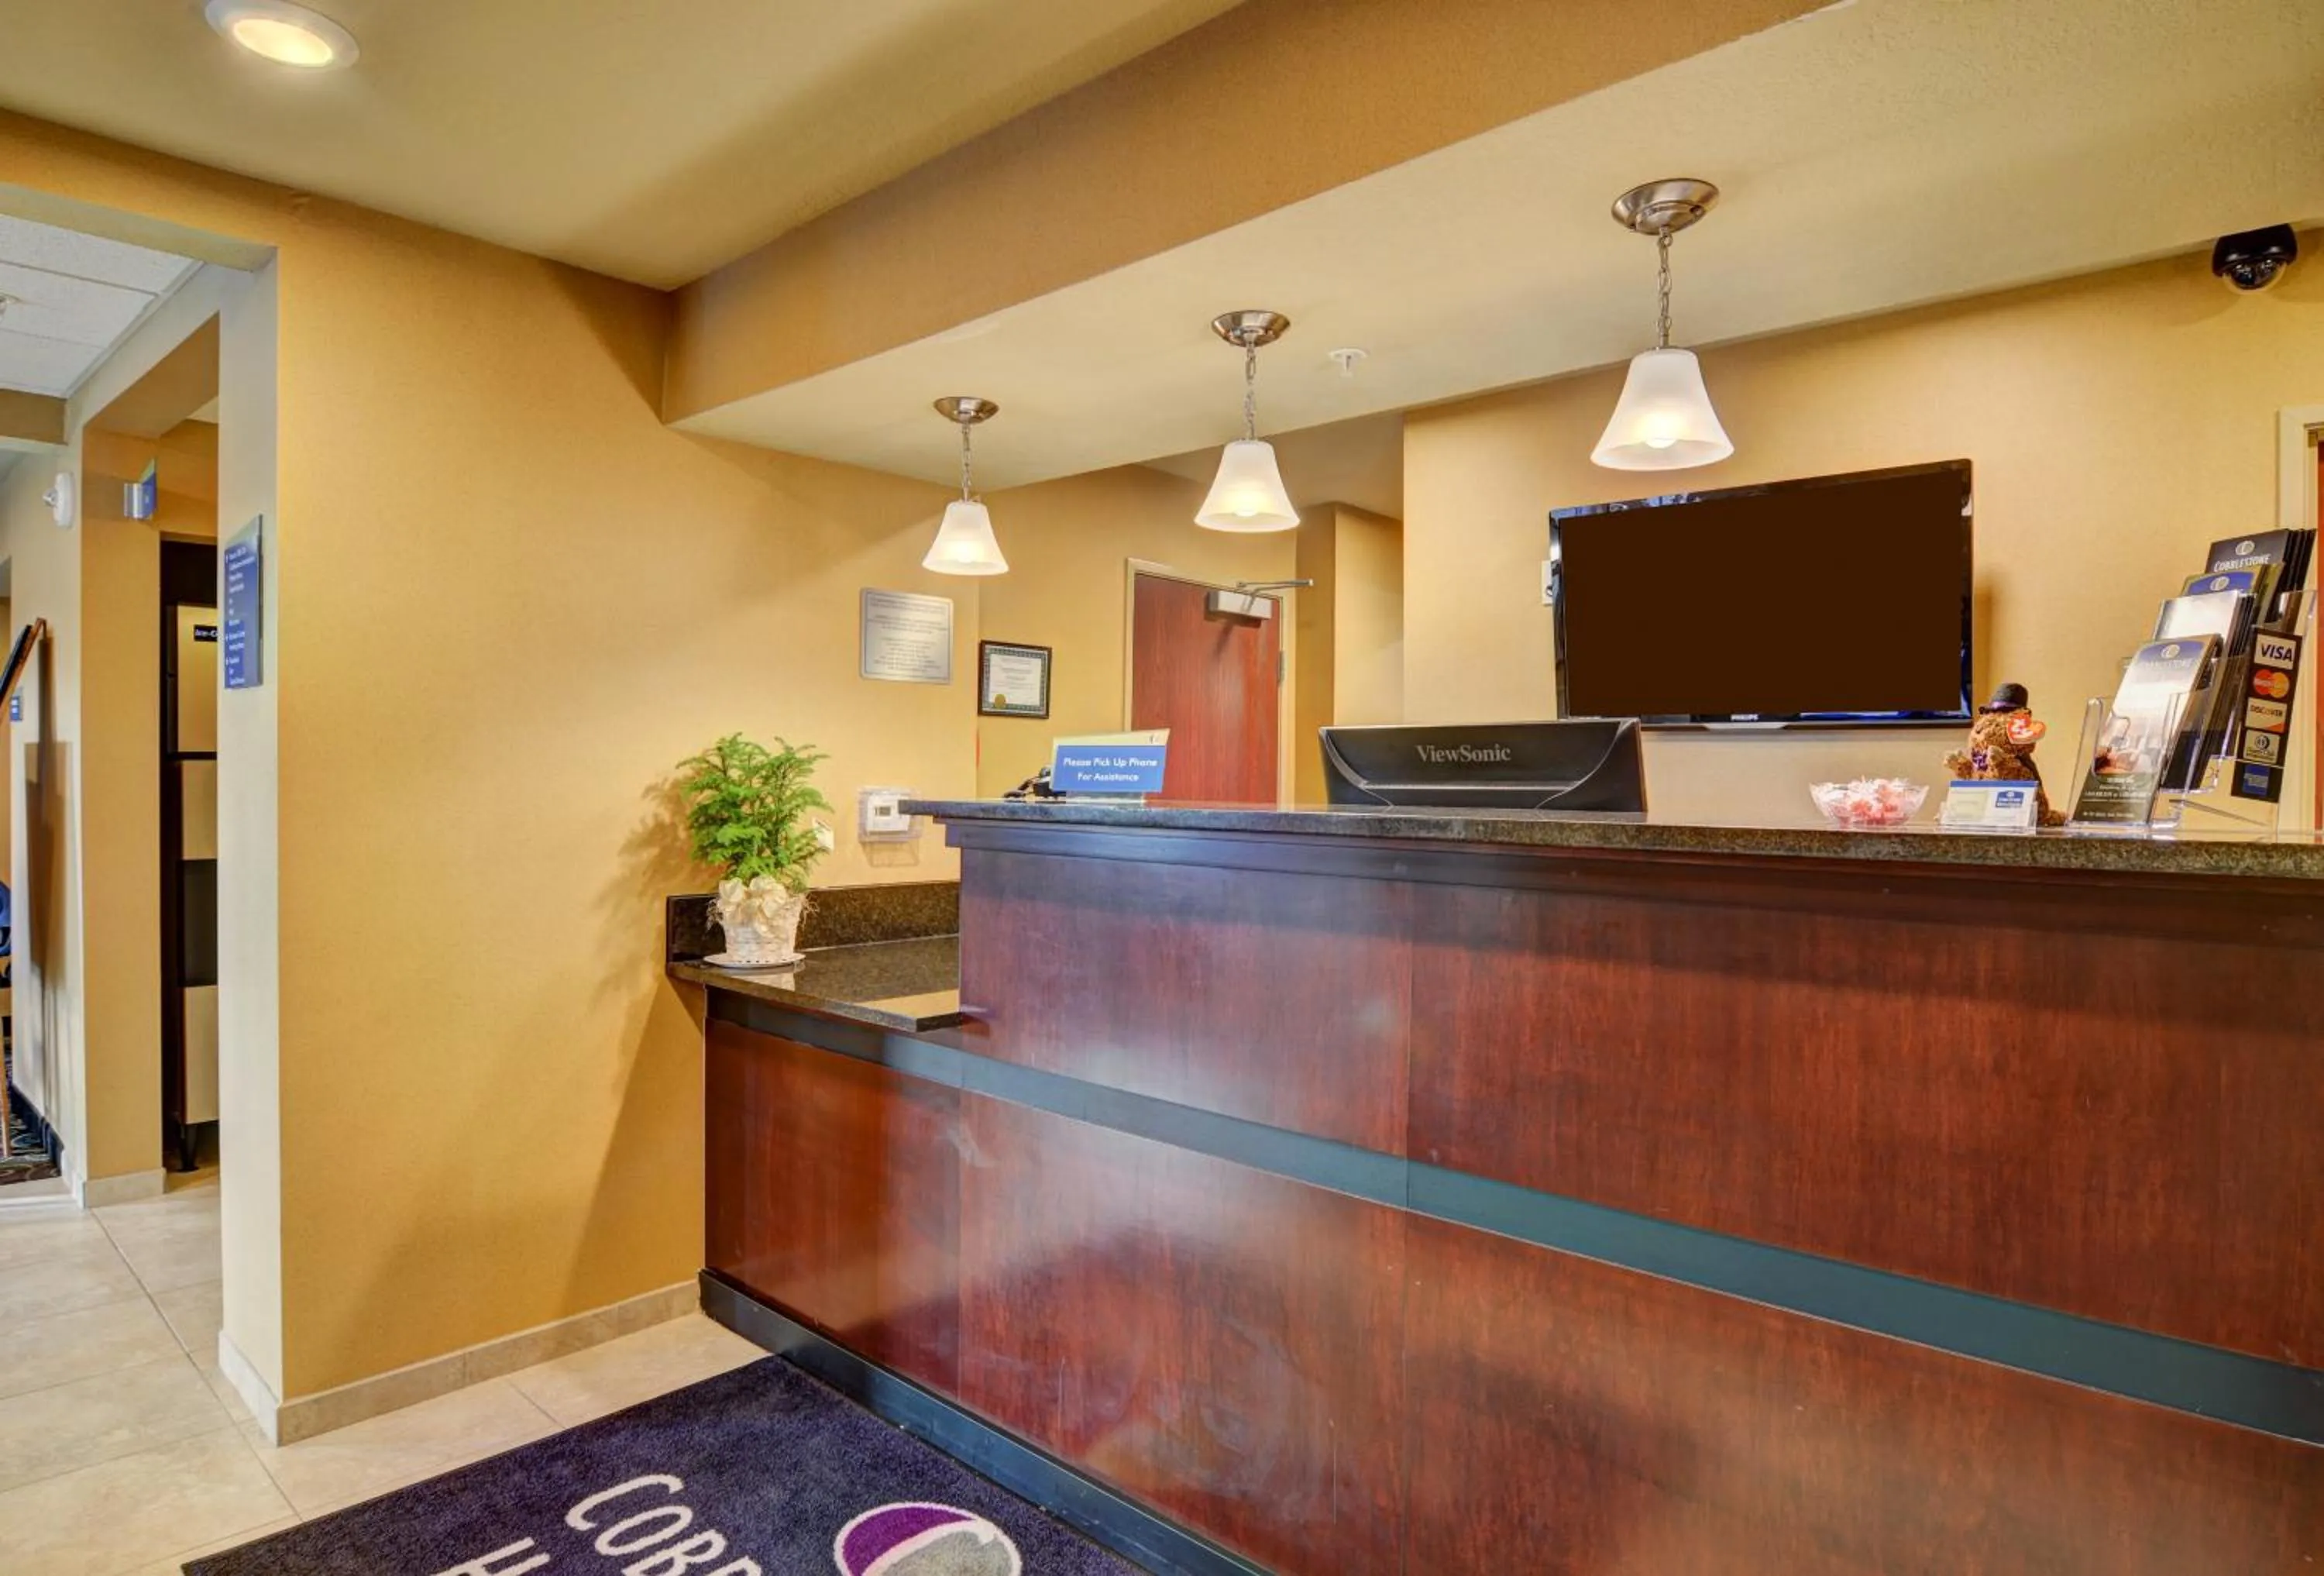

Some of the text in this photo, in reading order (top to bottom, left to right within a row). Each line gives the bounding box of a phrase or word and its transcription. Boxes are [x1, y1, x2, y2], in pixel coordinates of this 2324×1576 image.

[2213, 553, 2272, 573] COBBLESTONE
[2261, 642, 2293, 662] VISA
[1063, 757, 1158, 768] Please Pick Up Phone
[1415, 743, 1512, 763] ViewSonic
[1078, 771, 1140, 782] For Assistance
